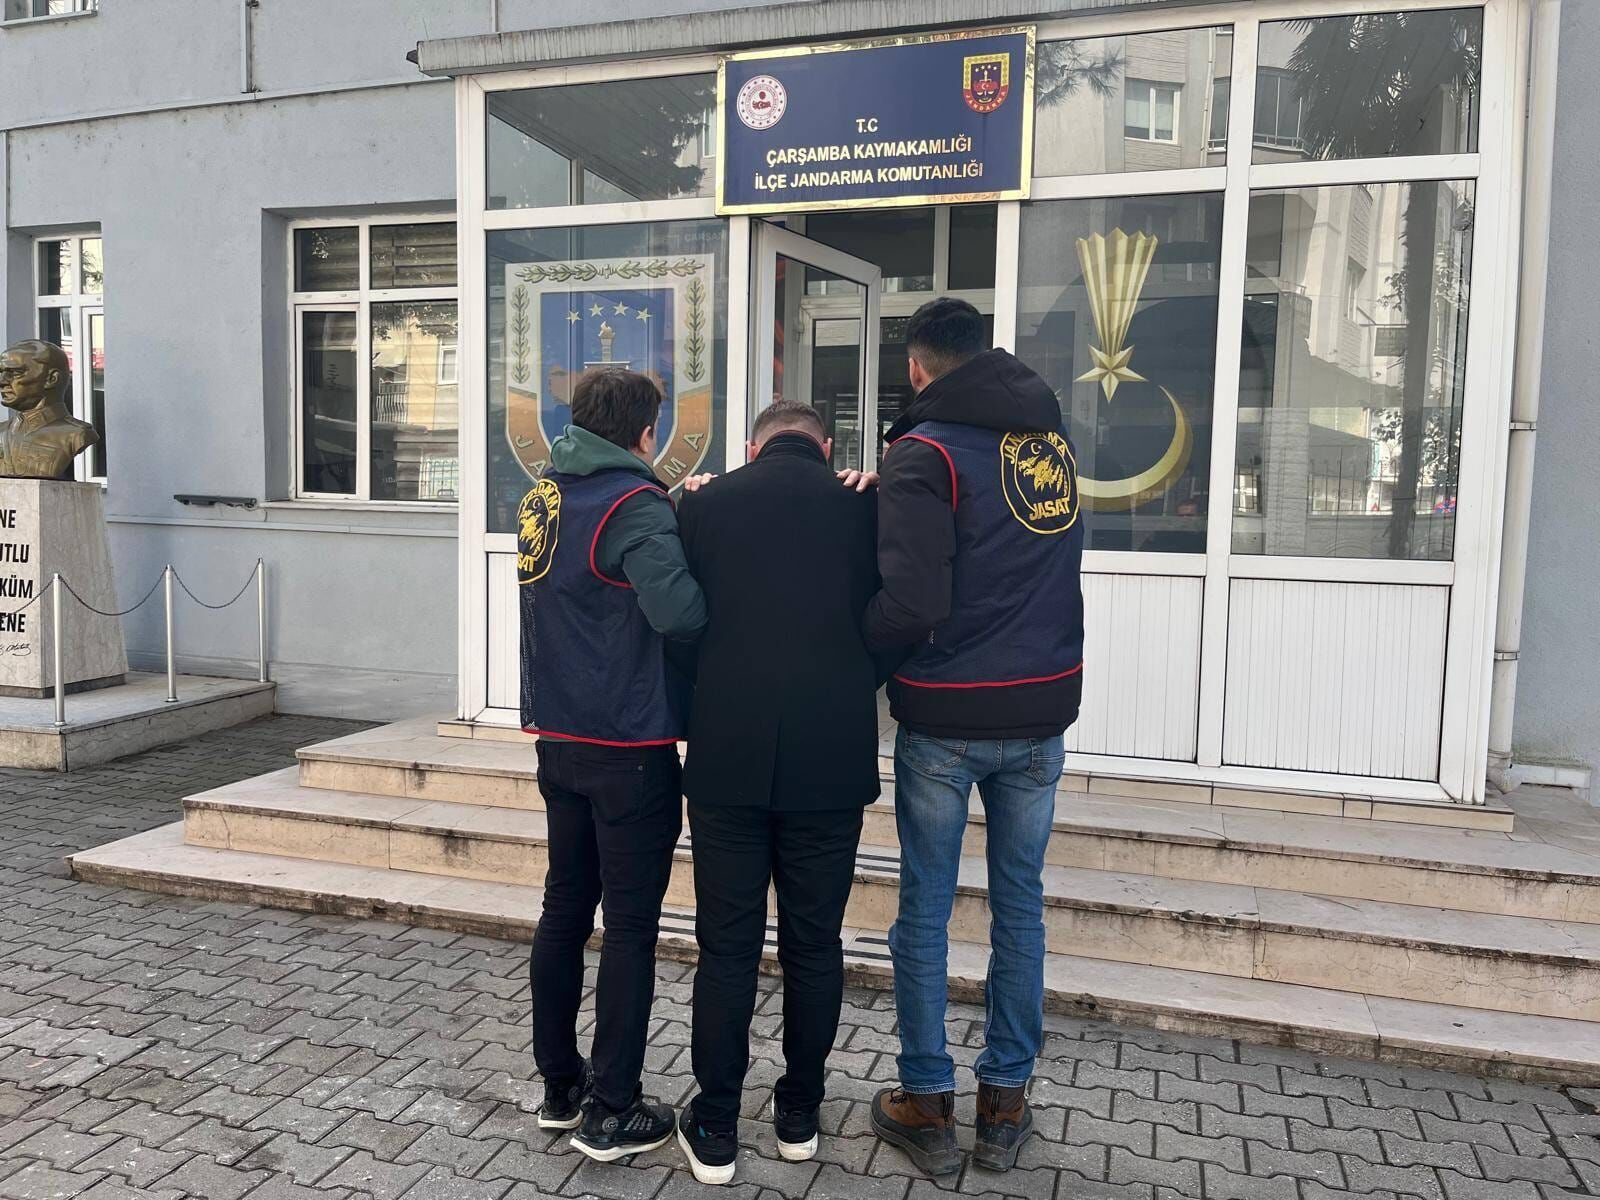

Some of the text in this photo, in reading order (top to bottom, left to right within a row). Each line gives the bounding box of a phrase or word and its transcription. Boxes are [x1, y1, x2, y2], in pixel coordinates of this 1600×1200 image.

[856, 118, 878, 133] T.C
[766, 134, 972, 167] ÇARŞAMBA KAYMAKAMLIĞI
[754, 159, 983, 192] İLÇE JANDARMA KOMUTANLIĞI
[1029, 497, 1070, 521] JASAT
